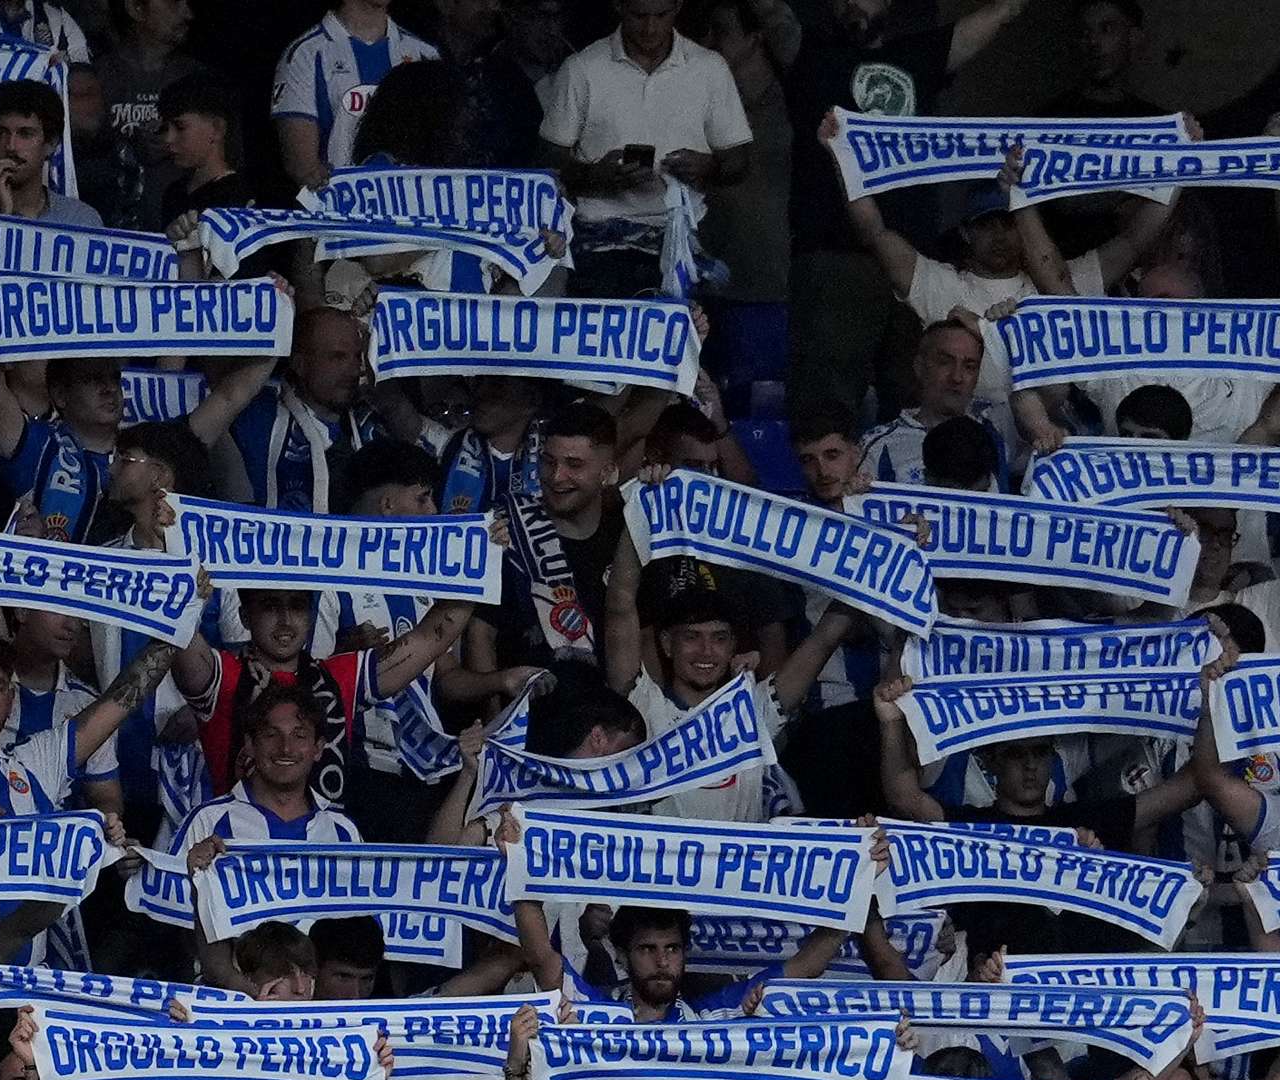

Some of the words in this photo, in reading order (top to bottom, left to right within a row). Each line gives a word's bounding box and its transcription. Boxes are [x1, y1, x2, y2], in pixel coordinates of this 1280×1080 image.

[152, 281, 276, 331] PERICO
[378, 300, 536, 354] ORGULLO
[553, 303, 689, 366] PERICO
[1000, 311, 1164, 364] ORGULLO
[1034, 447, 1212, 500] ORGULLO
[181, 513, 344, 564] ORGULLO
[358, 526, 488, 579] PERICO
[642, 488, 803, 568] ORGULLO
[1047, 519, 1186, 579] PERICO
[60, 561, 194, 616] PERICO
[641, 688, 759, 790] PERICO
[222, 858, 400, 899] ORGULLO
[524, 828, 705, 886] ORGULLO
[719, 843, 859, 901] PERICO
[888, 832, 1042, 888] ORGULLO
[1055, 858, 1188, 918] PERICO
[49, 1025, 222, 1076] ORGULLO
[234, 1035, 374, 1080] PERICO
[541, 1021, 731, 1069] ORGULLO
[764, 1028, 891, 1080] PERICO
